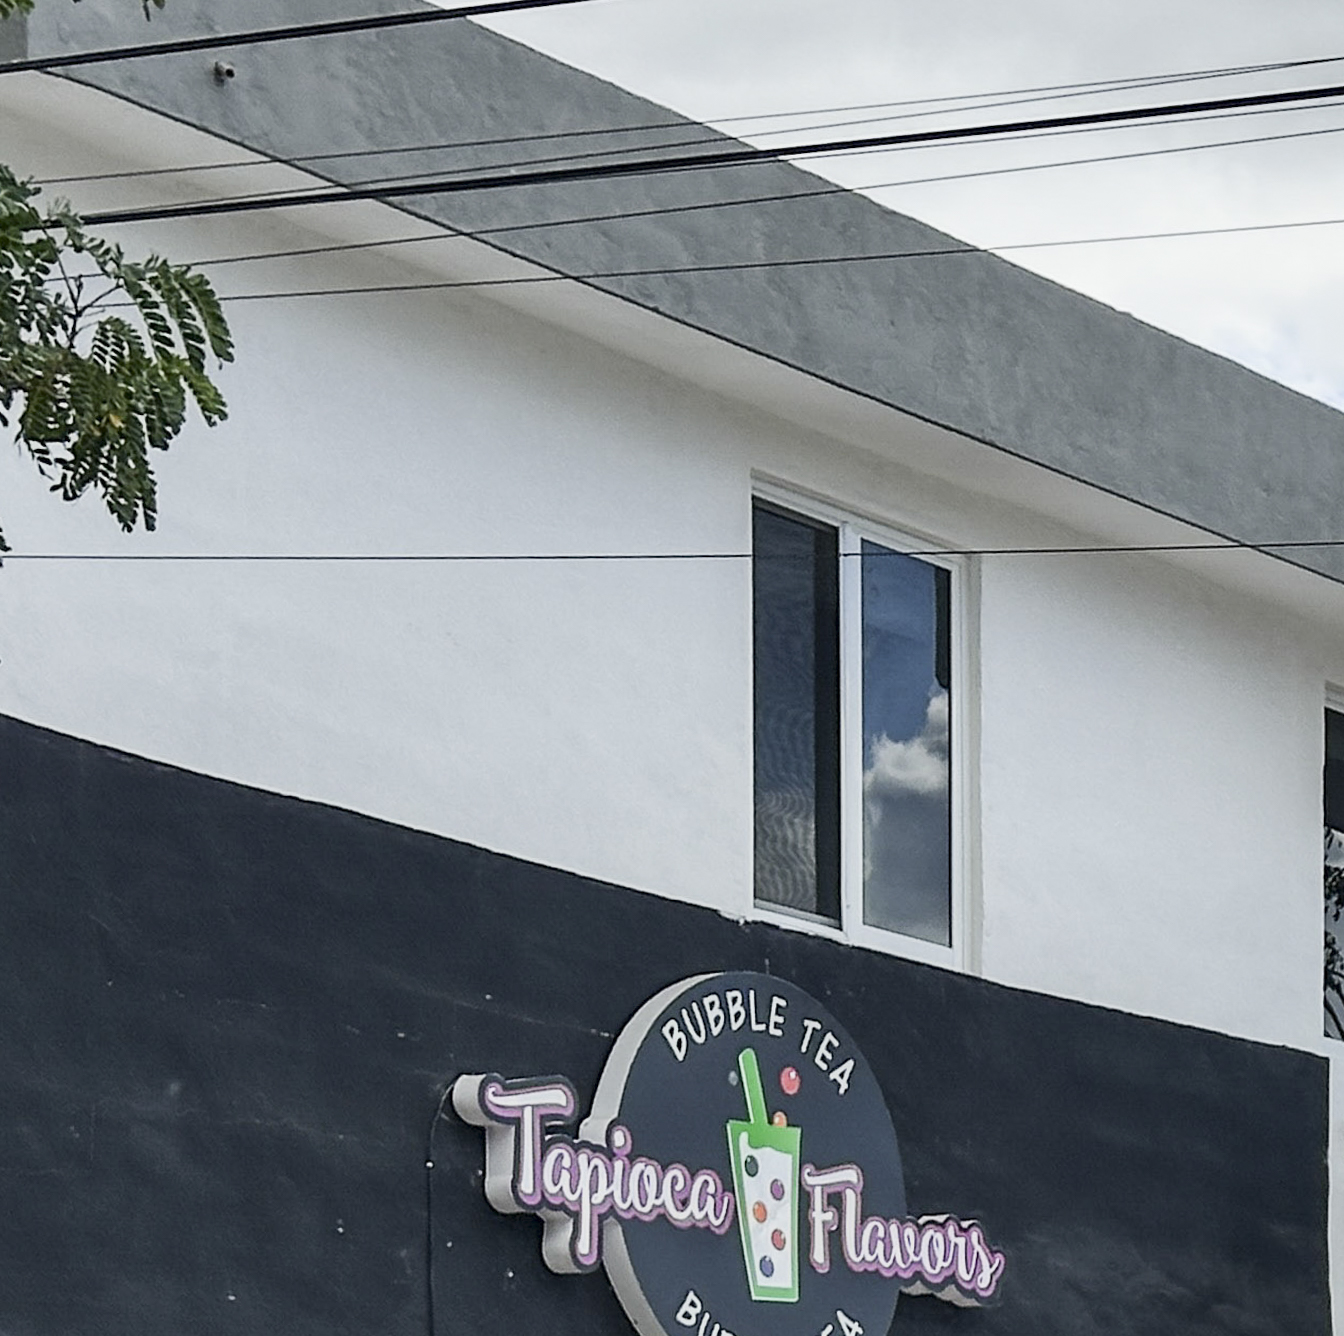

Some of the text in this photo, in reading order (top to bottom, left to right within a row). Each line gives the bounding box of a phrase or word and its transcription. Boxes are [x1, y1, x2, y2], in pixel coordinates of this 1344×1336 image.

[662, 989, 856, 1096] BUBBLE TEA
[486, 1083, 1004, 1292] Tapioca Flavors
